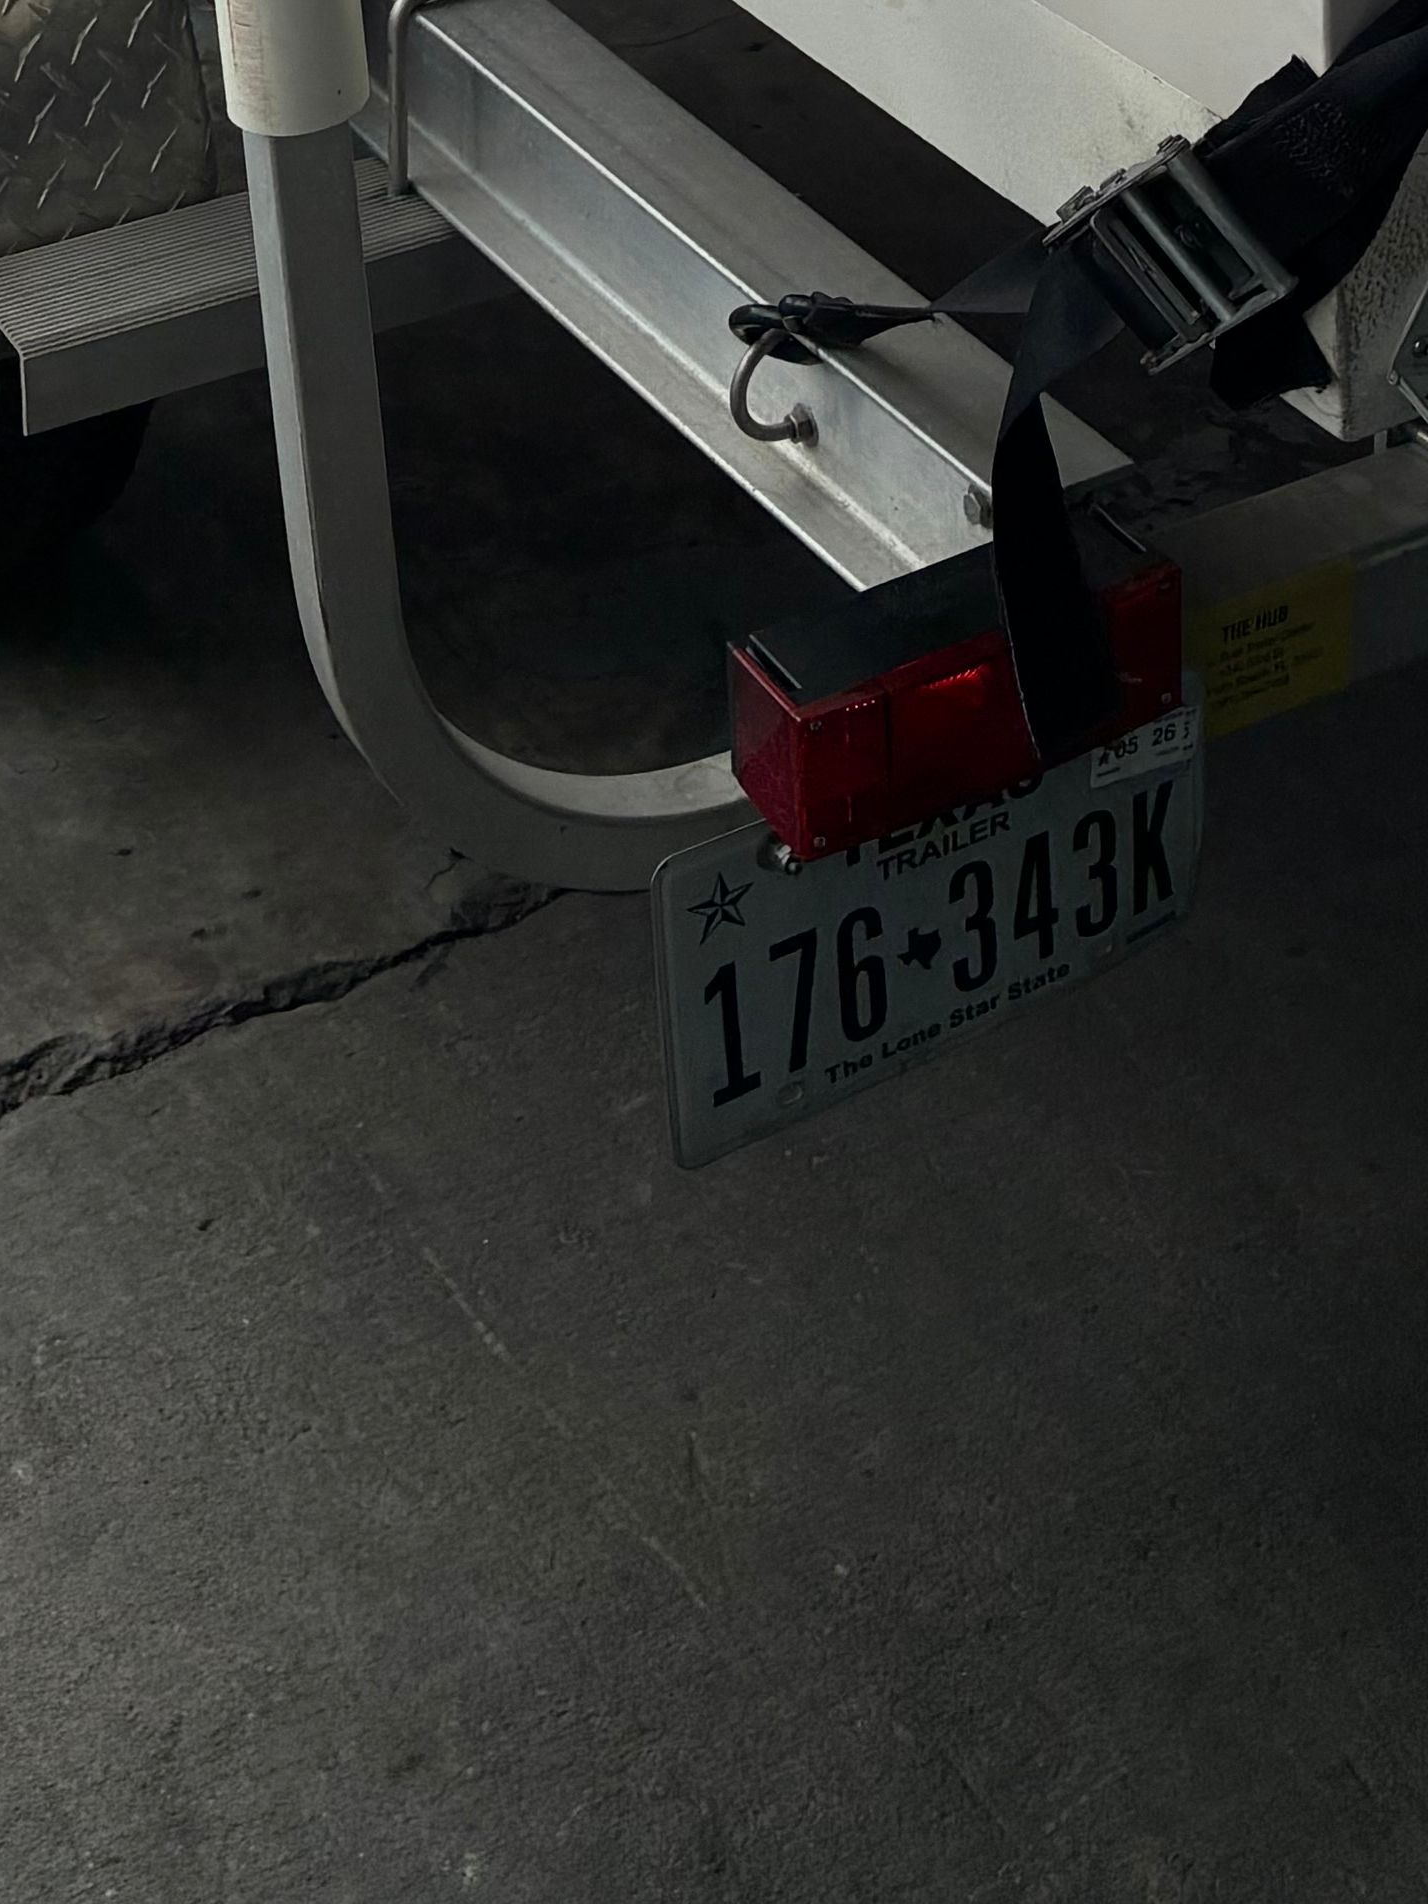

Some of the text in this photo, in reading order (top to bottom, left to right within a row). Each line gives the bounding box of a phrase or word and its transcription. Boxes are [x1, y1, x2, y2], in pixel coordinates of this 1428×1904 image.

[1222, 619, 1250, 643] THE
[1255, 606, 1289, 631] HUB
[1151, 723, 1176, 746] 26
[877, 810, 1010, 880] TRAILER
[703, 907, 886, 1107] 176
[948, 780, 1176, 993] 343K
[824, 962, 1070, 1086] The Lone Star State
